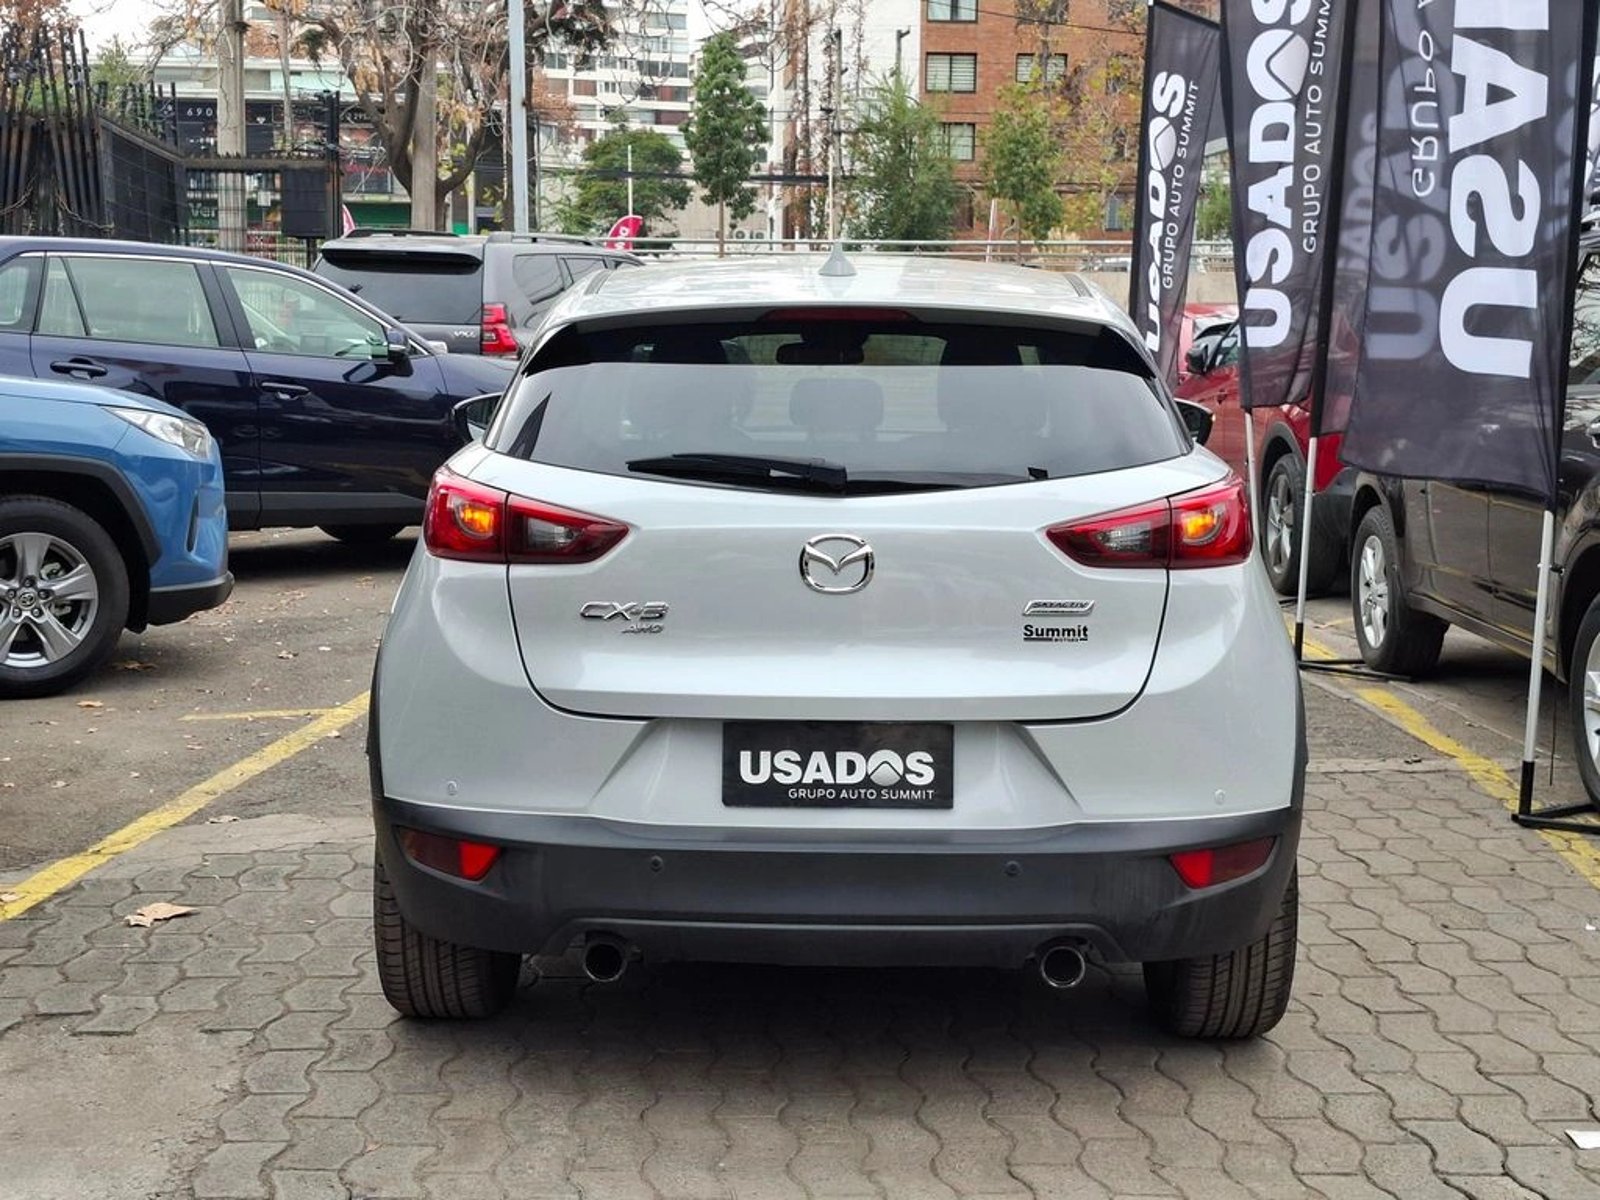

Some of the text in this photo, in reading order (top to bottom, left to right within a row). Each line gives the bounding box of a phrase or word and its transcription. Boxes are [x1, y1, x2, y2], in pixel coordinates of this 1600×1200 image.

[1304, 85, 1322, 154] AUTO
[1162, 81, 1199, 289] GRUPO AUTO SUMMIT
[1303, 164, 1321, 253] GRUPO
[580, 601, 669, 621] CX-3
[1023, 624, 1088, 637] Summit
[739, 749, 935, 787] USADOS
[788, 788, 935, 800] GRUPO AUTO SUMMIT
